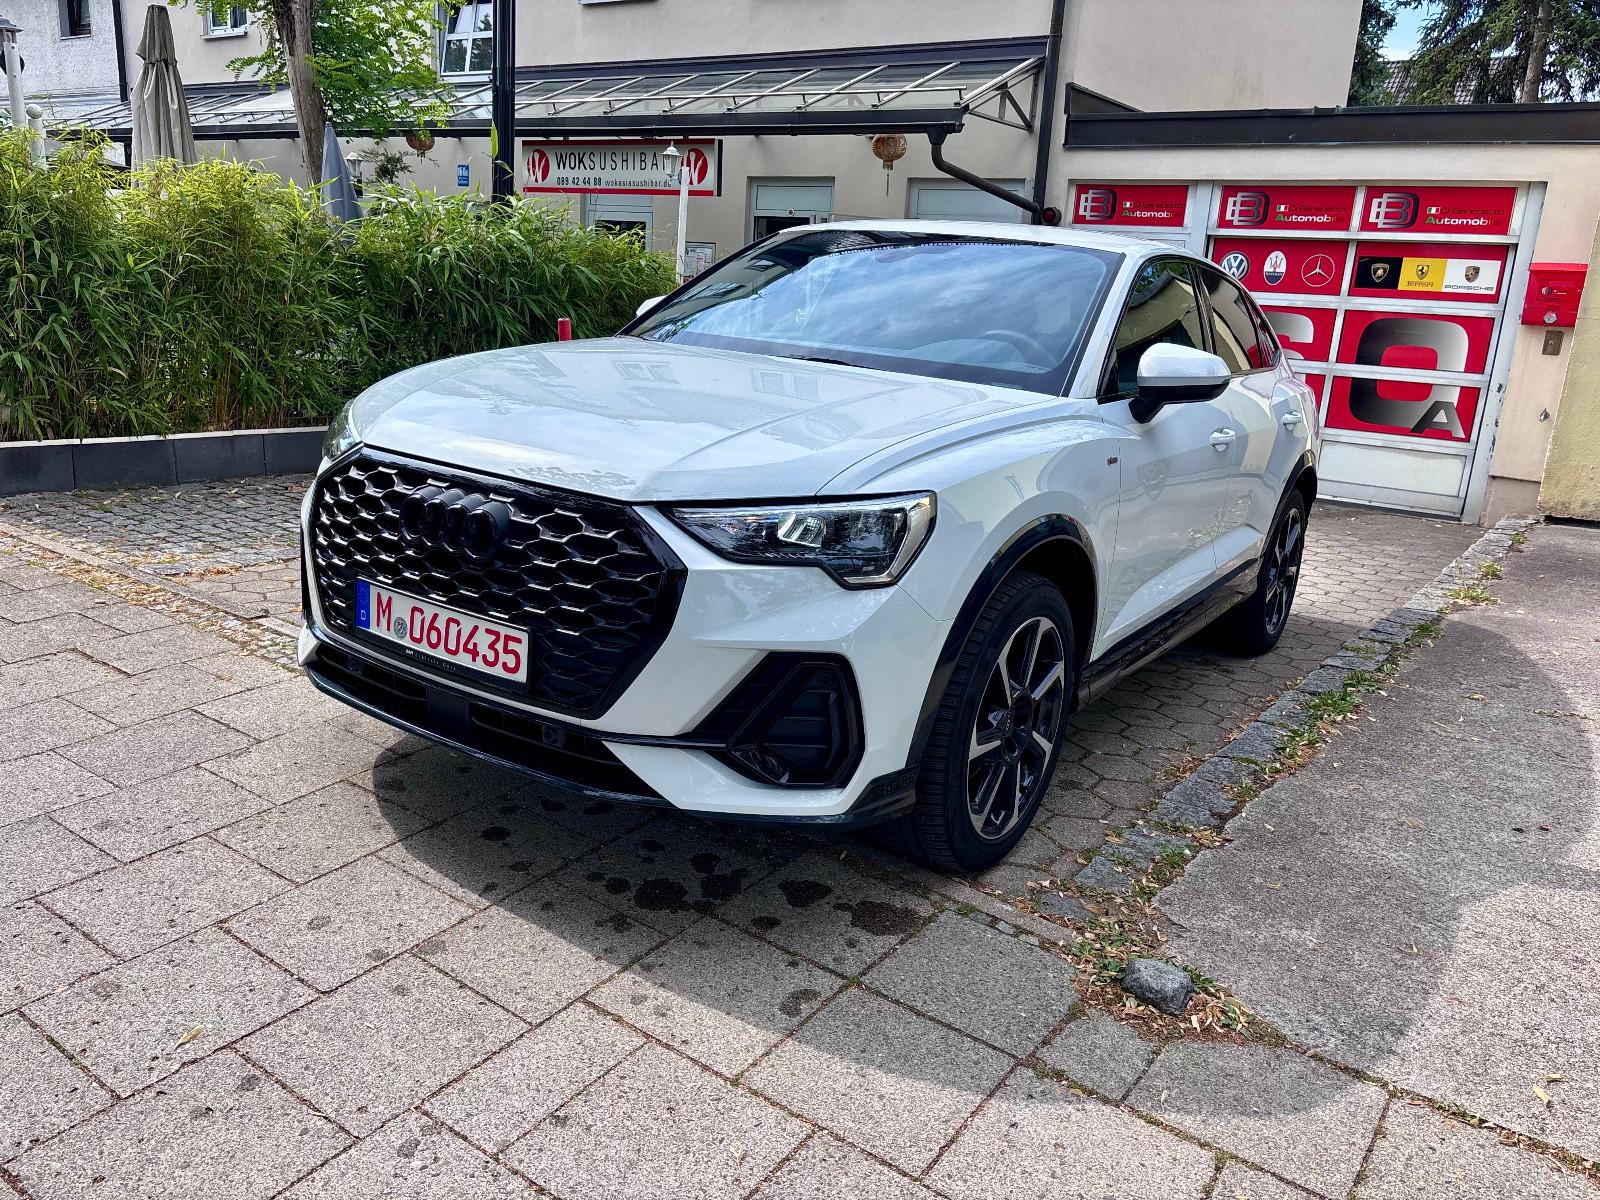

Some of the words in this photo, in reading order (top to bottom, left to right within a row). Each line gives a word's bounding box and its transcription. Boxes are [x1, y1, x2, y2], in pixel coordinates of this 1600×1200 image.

[556, 176, 570, 186] 089
[571, 176, 581, 186] 42
[582, 176, 592, 186] 44
[593, 177, 602, 186] 88
[360, 609, 367, 621] D
[376, 591, 393, 632] M
[408, 605, 523, 675] 060435
